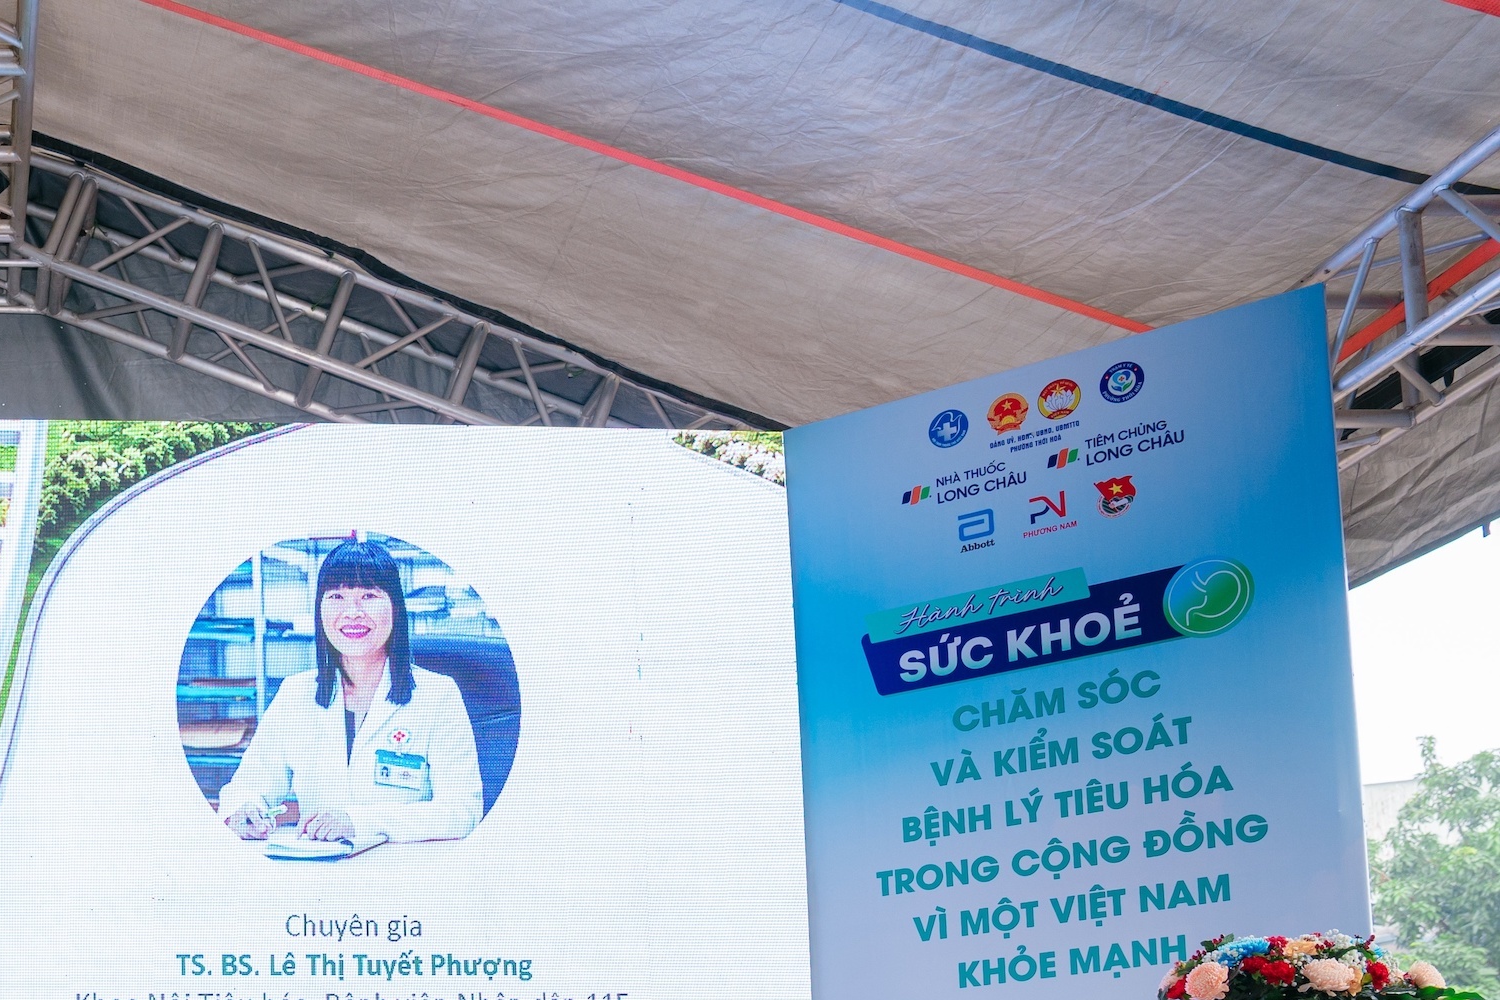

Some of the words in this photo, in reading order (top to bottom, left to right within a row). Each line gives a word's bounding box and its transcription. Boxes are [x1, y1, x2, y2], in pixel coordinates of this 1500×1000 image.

[1085, 433, 1115, 449] TIÊM
[1118, 420, 1167, 441] CHỦNG
[1086, 444, 1133, 466] LONG
[1137, 429, 1185, 452] CHÂU
[936, 472, 961, 488] NHÀ
[963, 460, 1006, 481] THUỐC
[937, 484, 980, 505] LONG
[984, 471, 1027, 492] CHÂU
[960, 538, 996, 553] Abbott
[1023, 524, 1058, 539] PHƯƠNG
[1059, 520, 1078, 530] NAM
[899, 632, 994, 684] SỨC
[1006, 593, 1143, 662] KHOẺ
[952, 686, 1066, 732] CHĂM
[1077, 667, 1161, 710] SÓC
[930, 748, 981, 786] VÀ
[993, 727, 1079, 778] KIỂM
[1091, 712, 1193, 759] SOÁT
[901, 805, 992, 847] BỆNH
[1004, 788, 1043, 827] LÝ
[1055, 779, 1129, 820] TIÊU
[1143, 762, 1234, 805] HÓA
[876, 854, 1000, 897] TRONG
[1011, 835, 1131, 881] CỘNG
[1143, 809, 1269, 859] ĐỒNG
[913, 907, 948, 942] VÌ
[960, 896, 1039, 940] MỘT
[1050, 883, 1127, 928] VIỆT
[1139, 873, 1232, 914] NAM
[285, 914, 379, 943] Chuyên
[387, 915, 423, 943] gia
[176, 954, 213, 976] TS.
[220, 954, 259, 976] BS.
[269, 952, 296, 976] Lê
[305, 953, 345, 980] Thị
[352, 950, 424, 981] Tuyết
[430, 953, 533, 981] Phượng
[958, 944, 1056, 989] KHỎE
[1069, 934, 1187, 979] MẠNH
